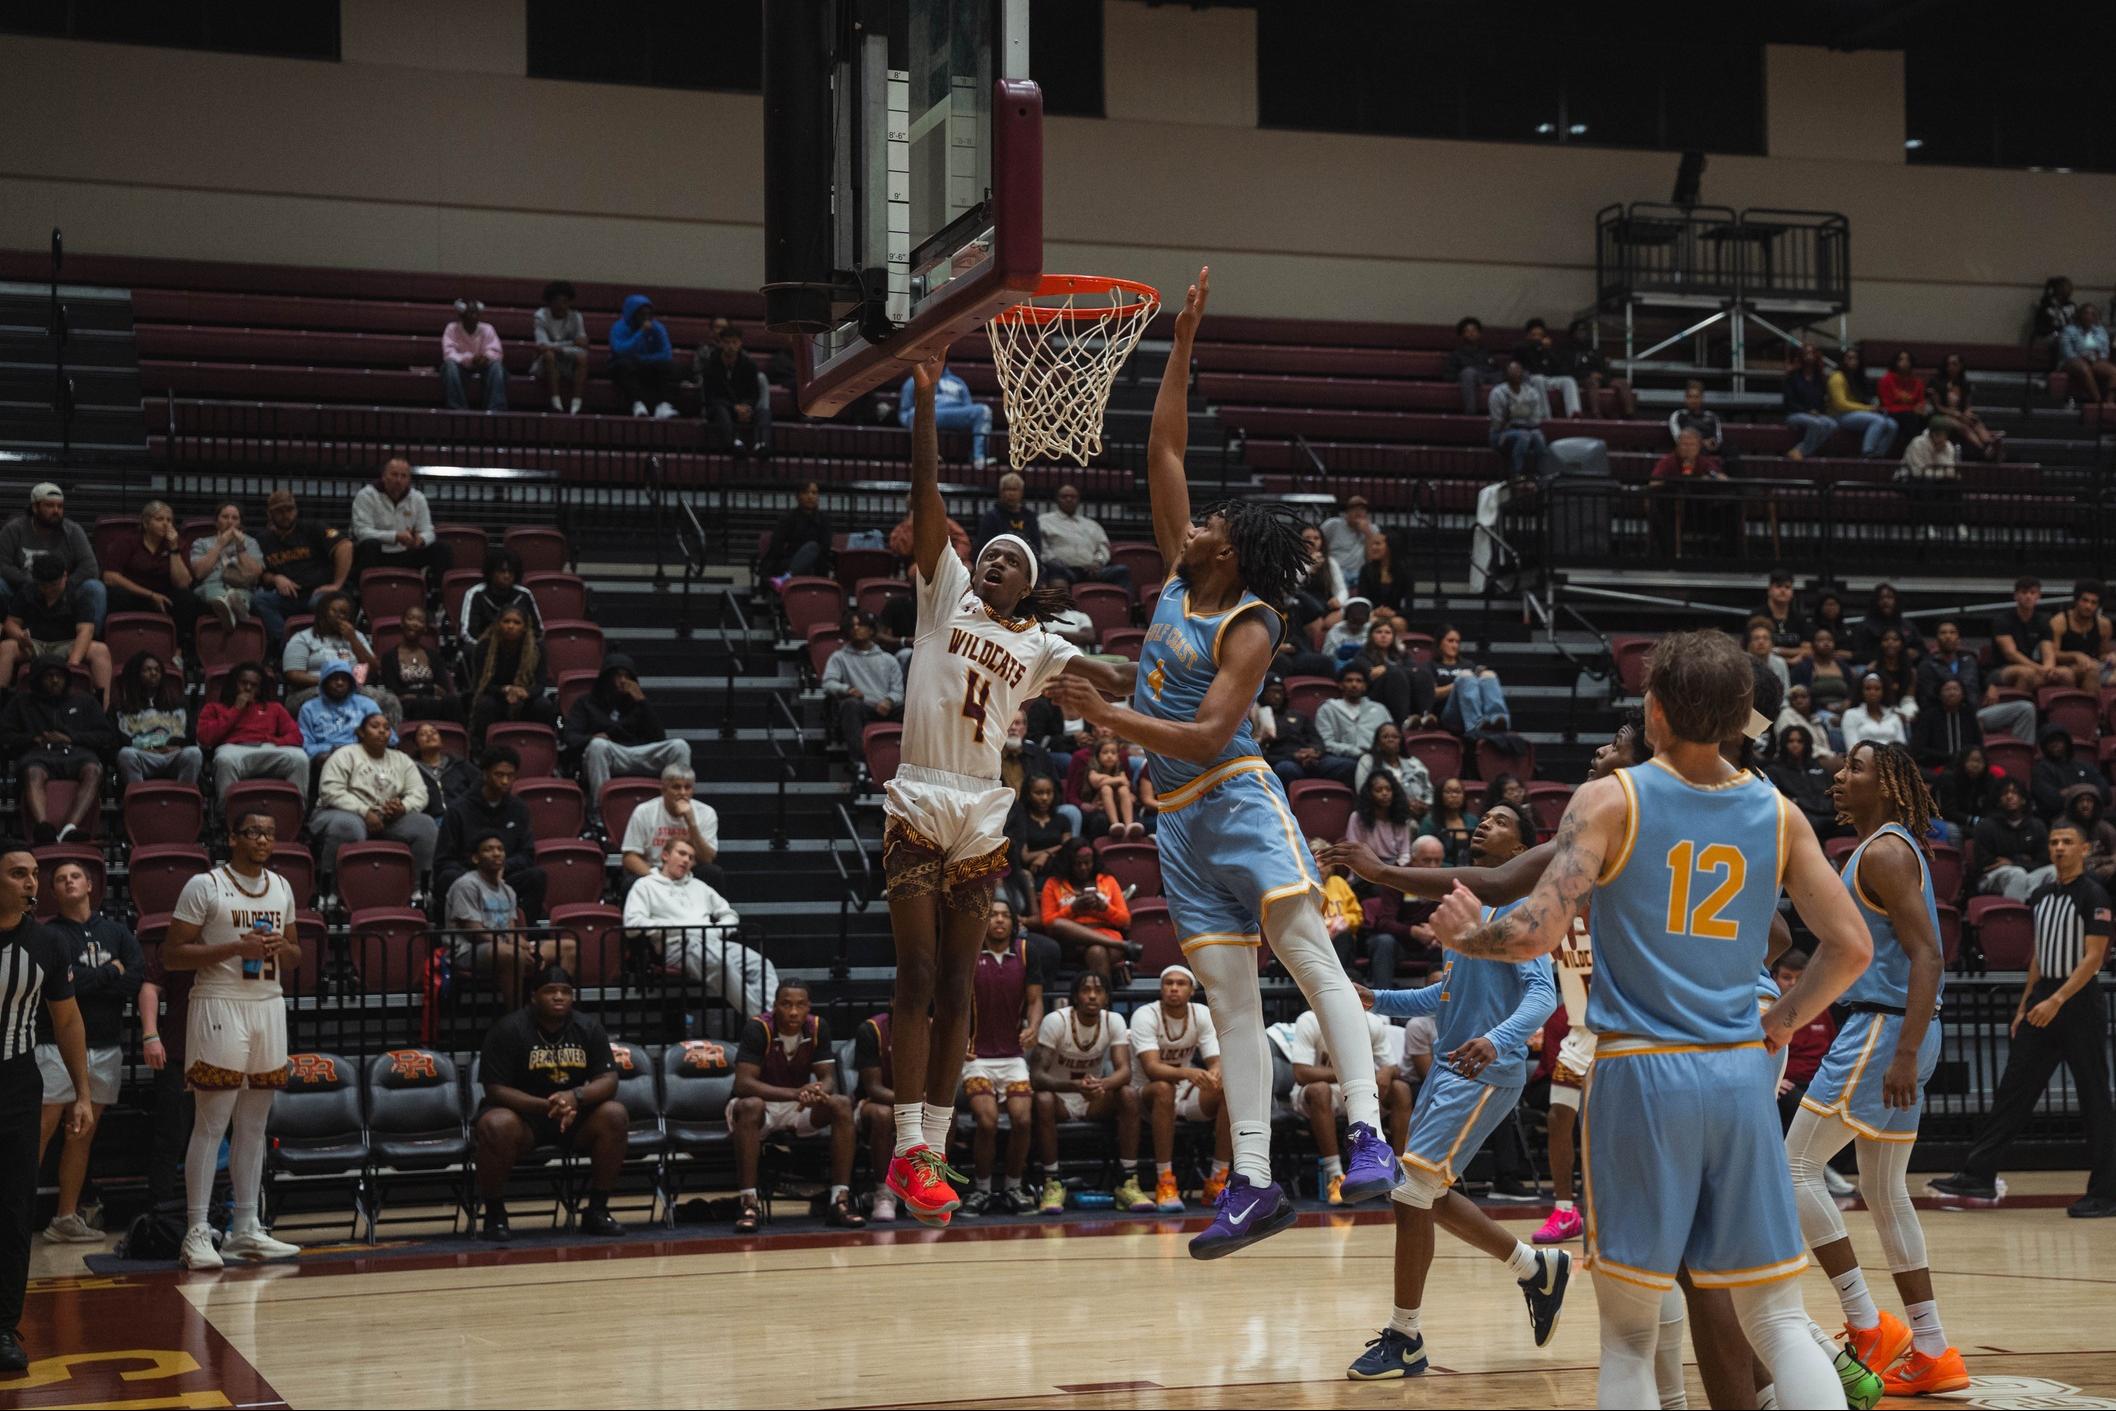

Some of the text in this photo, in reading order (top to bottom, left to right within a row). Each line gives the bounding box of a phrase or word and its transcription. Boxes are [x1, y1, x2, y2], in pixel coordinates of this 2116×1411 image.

[948, 628, 1027, 690] WILDCATS
[1148, 658, 1166, 702] 4
[962, 666, 992, 744] 4
[1665, 839, 1747, 941] 12
